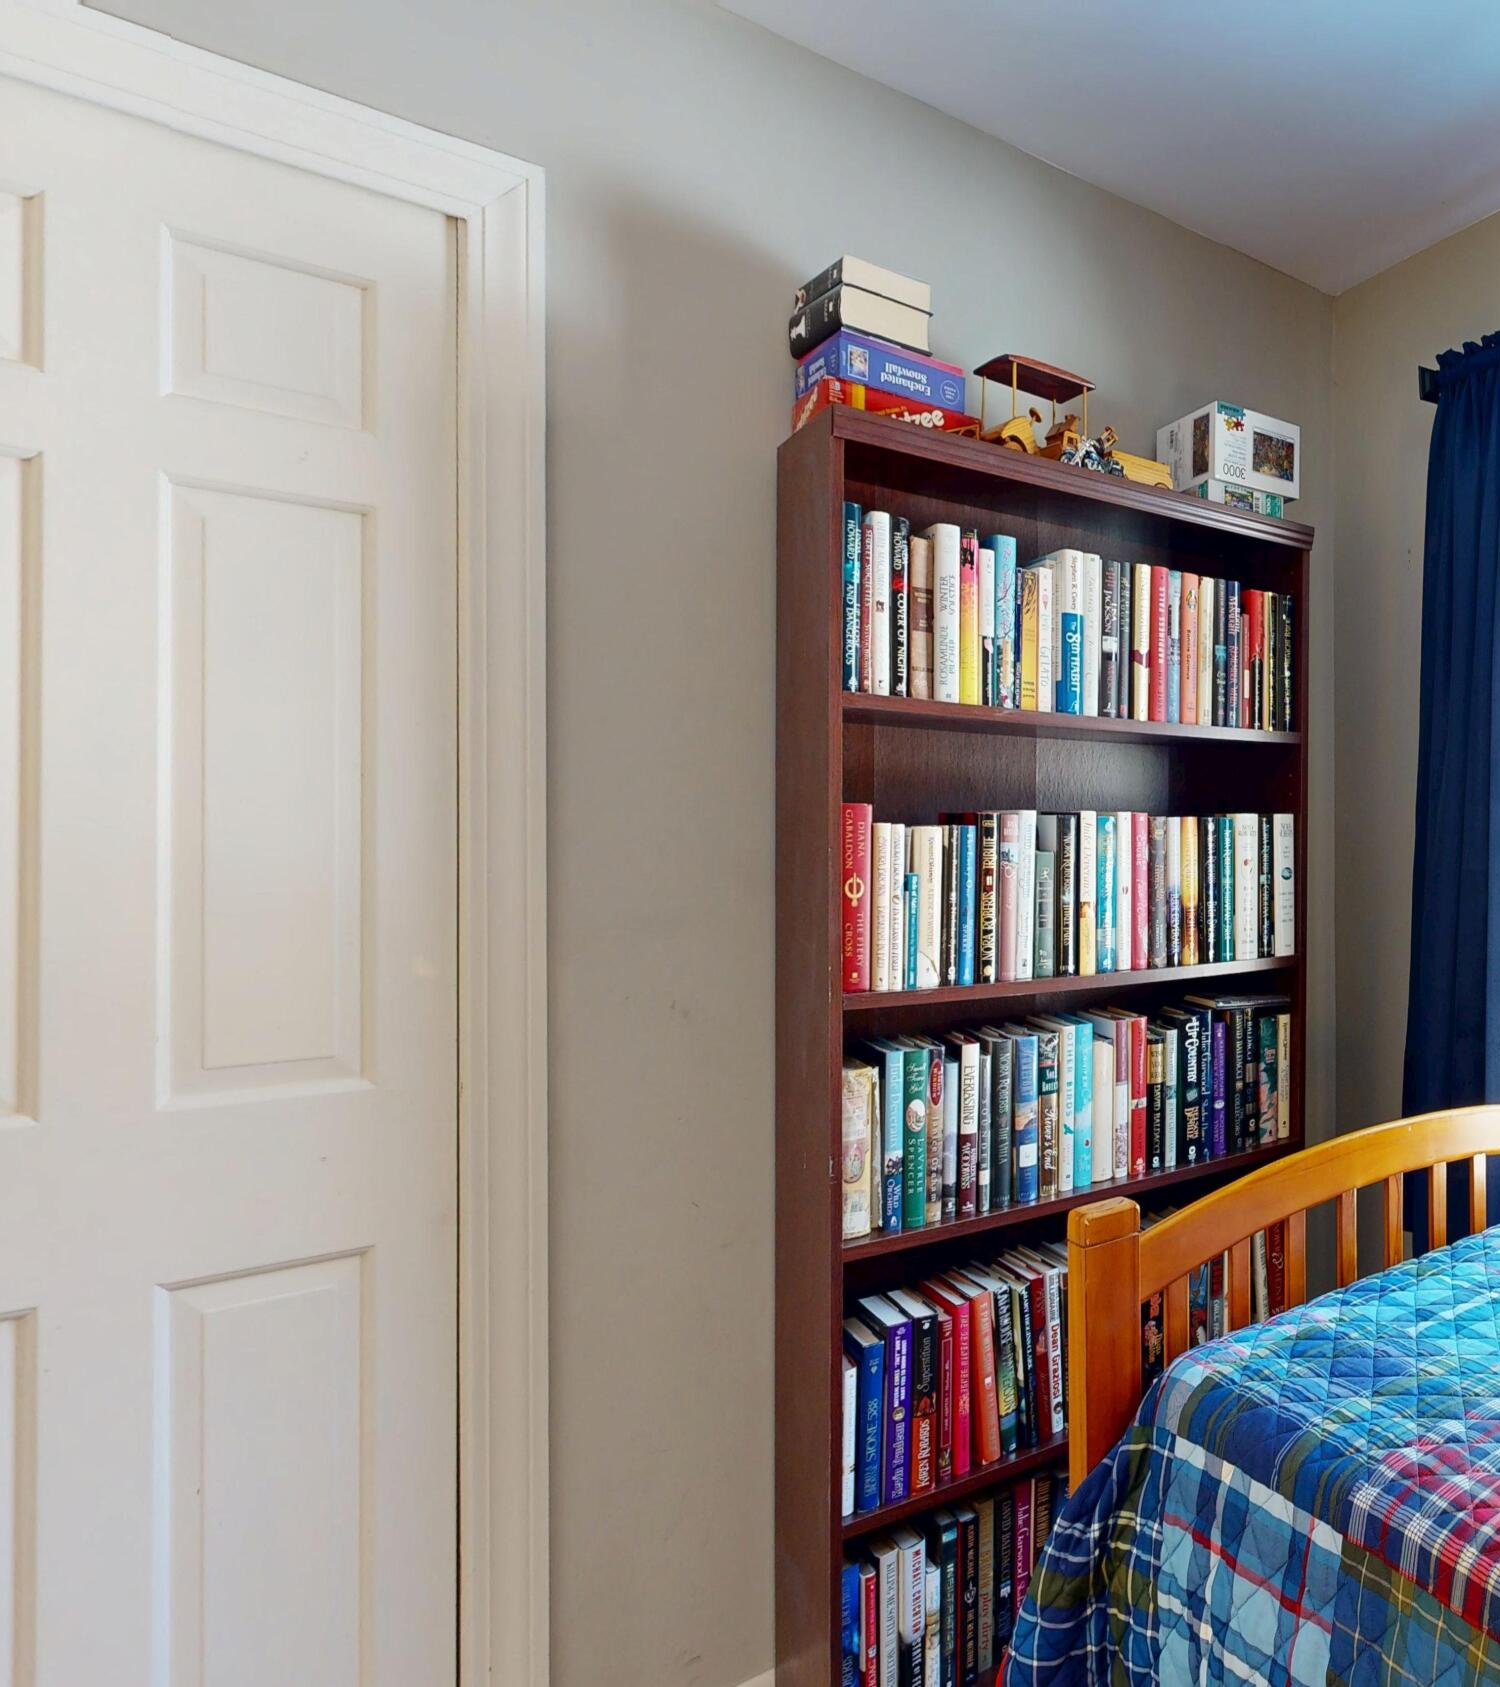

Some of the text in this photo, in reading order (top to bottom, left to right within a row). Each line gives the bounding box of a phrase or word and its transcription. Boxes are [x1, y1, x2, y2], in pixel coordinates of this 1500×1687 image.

[880, 373, 933, 397] Enchanted
[885, 362, 930, 384] Snowfall
[1223, 463, 1246, 480] 3000
[847, 520, 856, 559] HOWARD
[894, 532, 903, 570] HOWARD
[938, 576, 947, 612] WINTER
[1071, 557, 1079, 610] Stephen Covey
[846, 583, 855, 665] AND DANGEROUS
[897, 593, 906, 677] COVER OF NIGHT
[1104, 591, 1113, 633] JACKSON
[938, 625, 948, 686] ROSAMUNDE
[1071, 657, 1081, 692] HABIT
[845, 809, 853, 869] GABALDON
[857, 821, 865, 857] DIANA
[983, 836, 994, 869] TRIBUTE
[1063, 834, 1072, 858] NORA
[845, 923, 853, 957] CROSS
[856, 912, 865, 968] THE FIERY
[983, 893, 994, 961] NORA ROBERTS
[998, 1052, 1010, 1114] NORA ROBERTS
[1185, 1038, 1199, 1083] COUNTRY
[1201, 1027, 1212, 1095] Julie Garwood
[1235, 1041, 1243, 1079] BALDACCI
[889, 1061, 902, 1149] Jude Deveraux
[963, 1065, 975, 1125] EVERLASTING
[1066, 1081, 1074, 1118] BIRDS
[1153, 1084, 1161, 1154] DAVID BALDACCI
[999, 1141, 1009, 1165] VILLA
[1044, 1108, 1057, 1147] River's
[907, 1138, 917, 1195] SPENCER
[930, 1115, 940, 1203] Janice Graham
[1044, 1149, 1057, 1170] End
[887, 1178, 896, 1216] ORCHIDS
[892, 1183, 902, 1209] WILD
[998, 1286, 1013, 1344] CAT MOUSE
[1048, 1273, 1057, 1323] MILLIONAIRE
[917, 1336, 934, 1393] Superstition
[960, 1314, 968, 1394] THE SEVENTH SENSE
[1051, 1322, 1063, 1400] Dean Graziosi
[865, 1397, 879, 1462] STONE 588
[917, 1418, 931, 1488] KAREN ROBARDS
[892, 1421, 905, 1499] Kevin Trudeau
[1001, 1500, 1012, 1581] DAVID BALDACCI
[1017, 1503, 1029, 1527] Julie
[1037, 1481, 1050, 1549] JULIE GARWOOD
[980, 1548, 991, 1590] BROWN
[1017, 1526, 1029, 1578] Garwood
[912, 1547, 922, 1635] MICHAEL CRICHTON
[979, 1591, 990, 1651] play dirty
[912, 1636, 921, 1665] STATE
